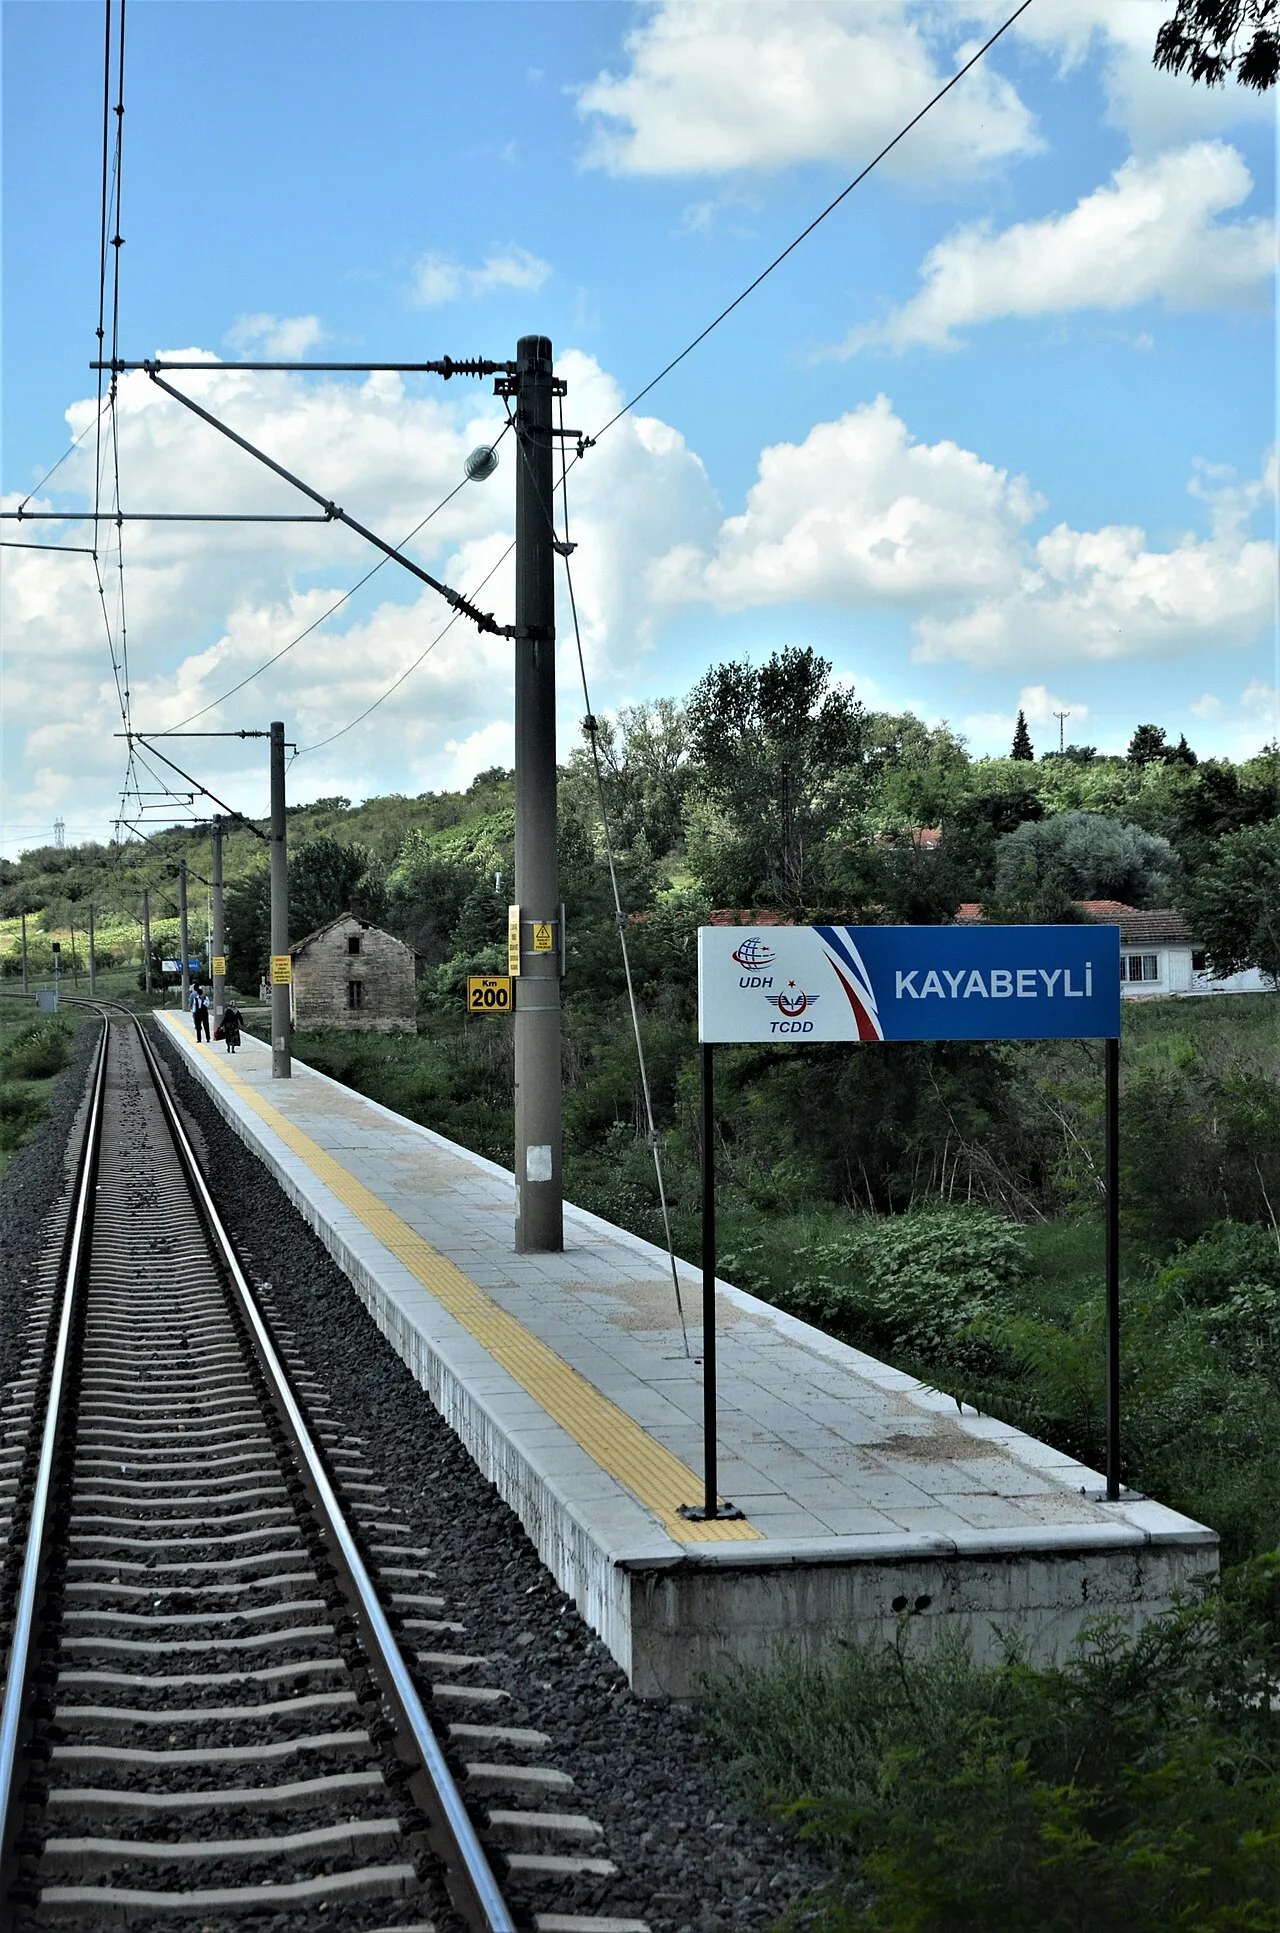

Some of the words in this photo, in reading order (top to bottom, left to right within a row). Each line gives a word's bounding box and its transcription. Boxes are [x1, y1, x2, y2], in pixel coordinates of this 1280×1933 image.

[739, 976, 774, 989] UDH
[895, 961, 1092, 999] KAYABEYLİ
[471, 988, 508, 1007] 200
[769, 1021, 814, 1033] TCDD
